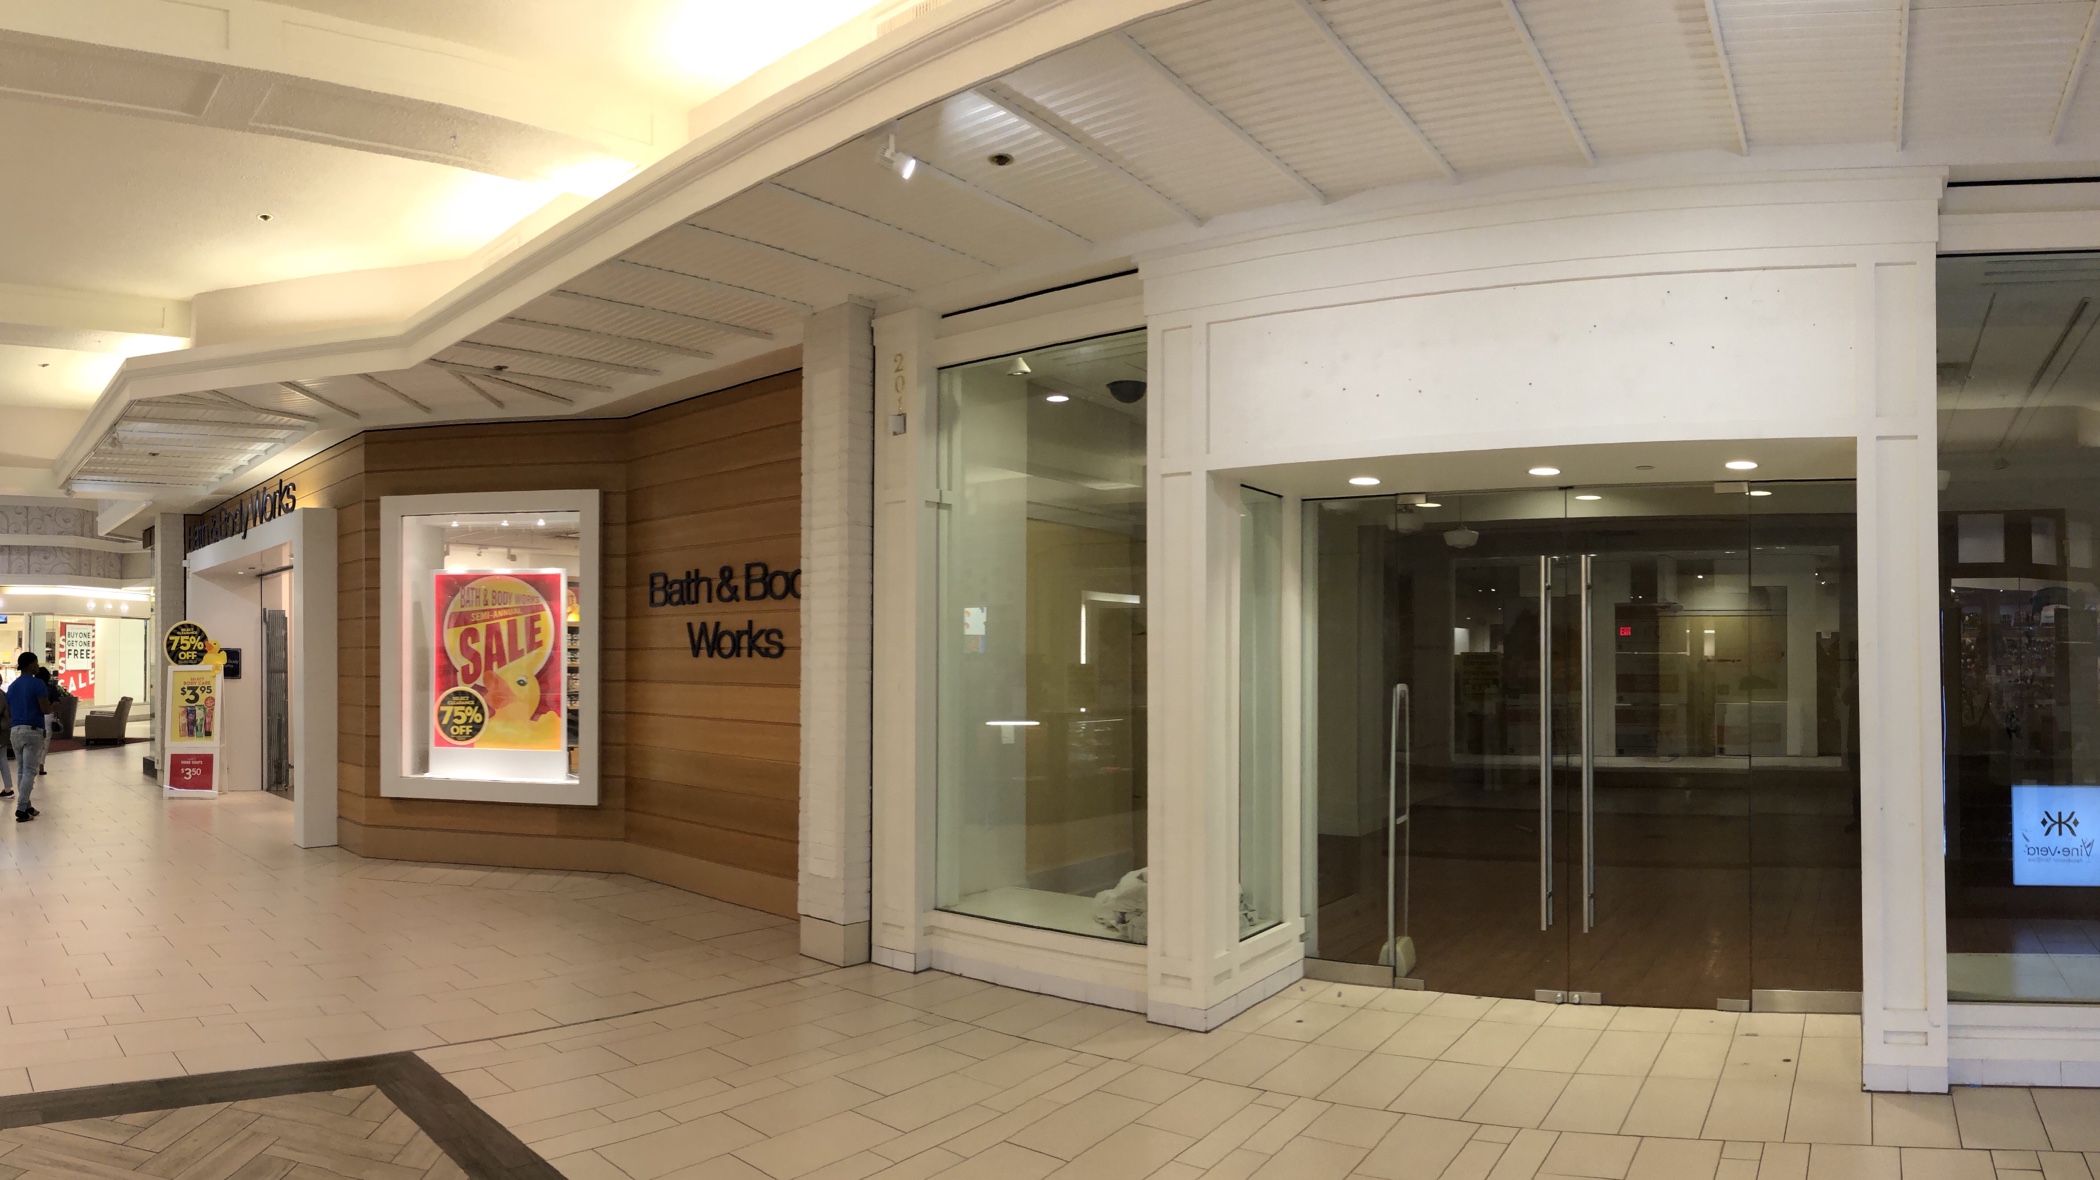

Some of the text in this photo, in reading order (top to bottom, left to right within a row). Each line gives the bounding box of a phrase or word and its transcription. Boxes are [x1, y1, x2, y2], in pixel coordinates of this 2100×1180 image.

[219, 499, 250, 540] Body
[250, 478, 297, 527] Works
[649, 562, 802, 608] Bath & Bo
[460, 586, 480, 608] BATH
[483, 588, 489, 607] &
[491, 589, 513, 606] BODY
[67, 631, 79, 639] BUY
[168, 635, 204, 651] 75%
[686, 620, 786, 659] Works
[67, 649, 91, 659] FREE
[178, 651, 198, 660] OFF
[459, 613, 543, 685] SALE
[440, 705, 483, 725] 75%
[450, 725, 473, 735] OFF
